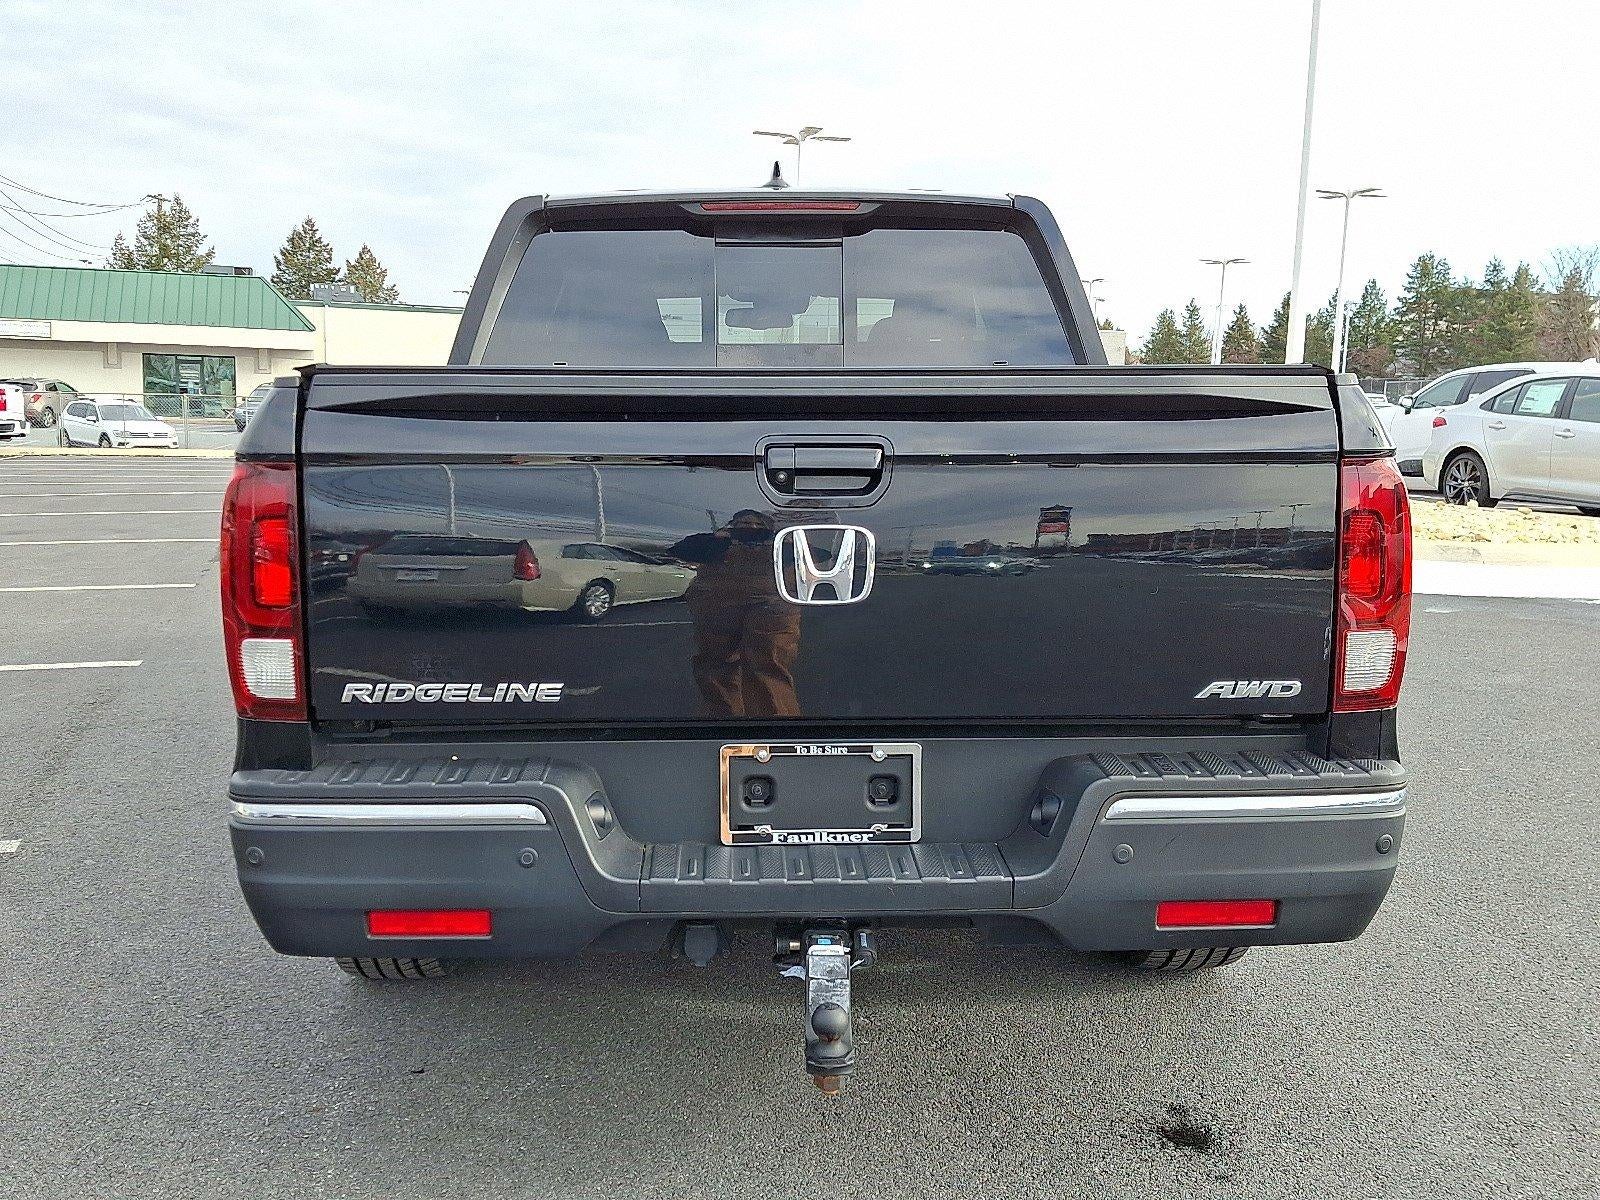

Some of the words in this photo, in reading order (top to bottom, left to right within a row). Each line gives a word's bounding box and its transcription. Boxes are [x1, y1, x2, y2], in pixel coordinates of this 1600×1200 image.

[341, 682, 565, 704] RIDGELINE
[1194, 680, 1302, 699] AWD
[794, 745, 808, 754] To
[809, 745, 823, 754] Be
[824, 745, 849, 754] Sure
[772, 831, 874, 844] Faulkner
